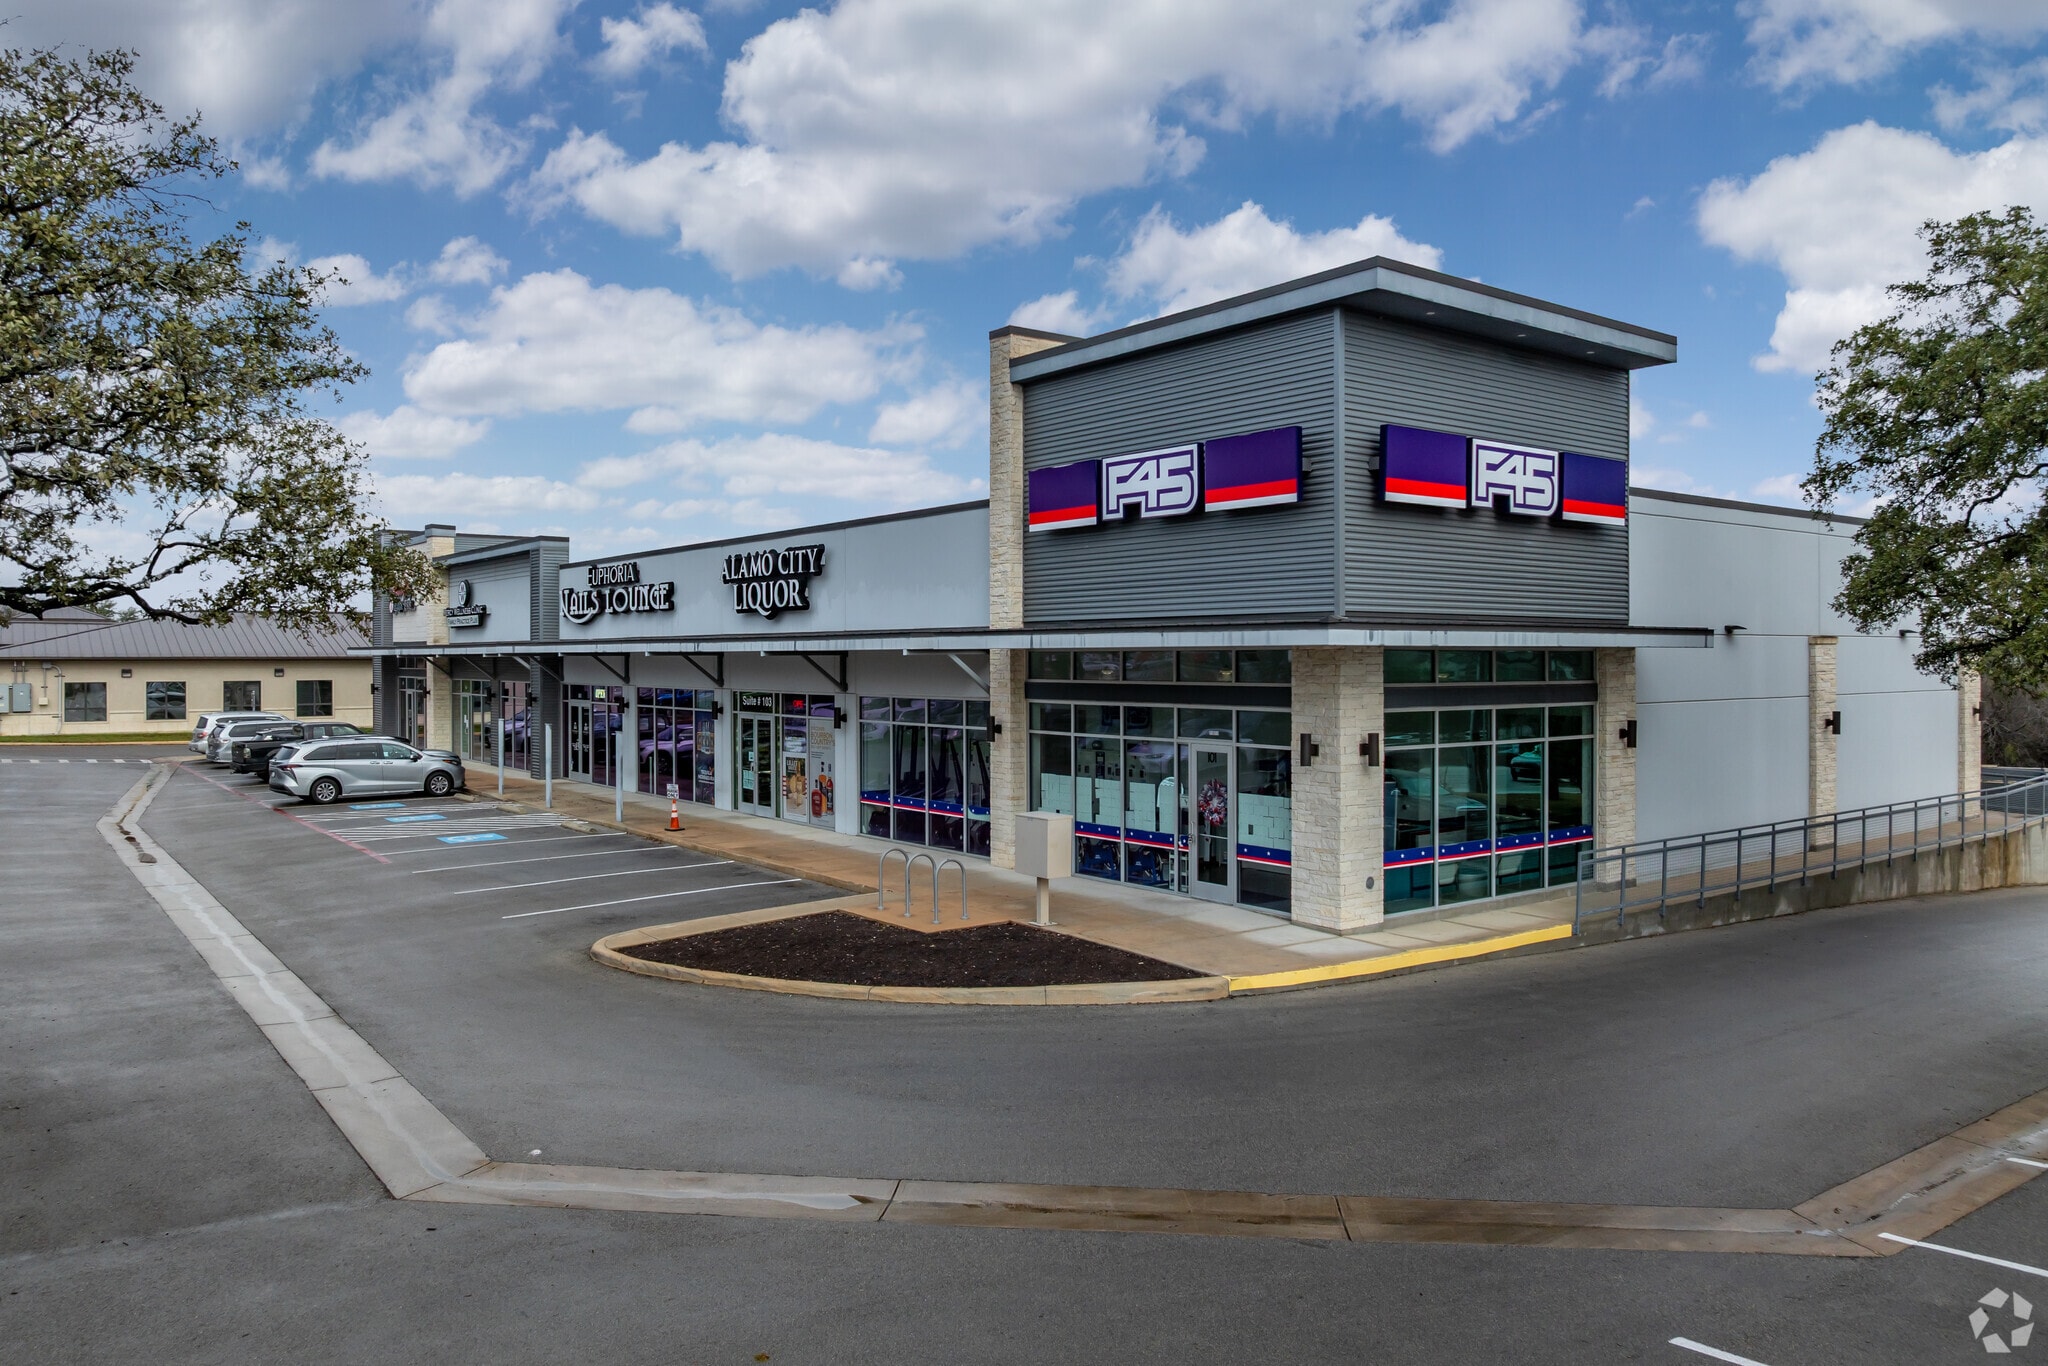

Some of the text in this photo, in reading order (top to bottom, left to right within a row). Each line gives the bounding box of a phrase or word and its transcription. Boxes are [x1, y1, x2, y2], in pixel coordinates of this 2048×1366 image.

[1107, 451, 1193, 513] F45
[1476, 446, 1554, 509] F45
[587, 564, 634, 586] EUPHORIA
[721, 548, 817, 580] ALAMO CITY
[559, 583, 669, 624] NAILS LOUNGE
[733, 579, 803, 616] LIQUOR
[742, 695, 772, 707] Suite # 103
[1207, 752, 1217, 763] 101
